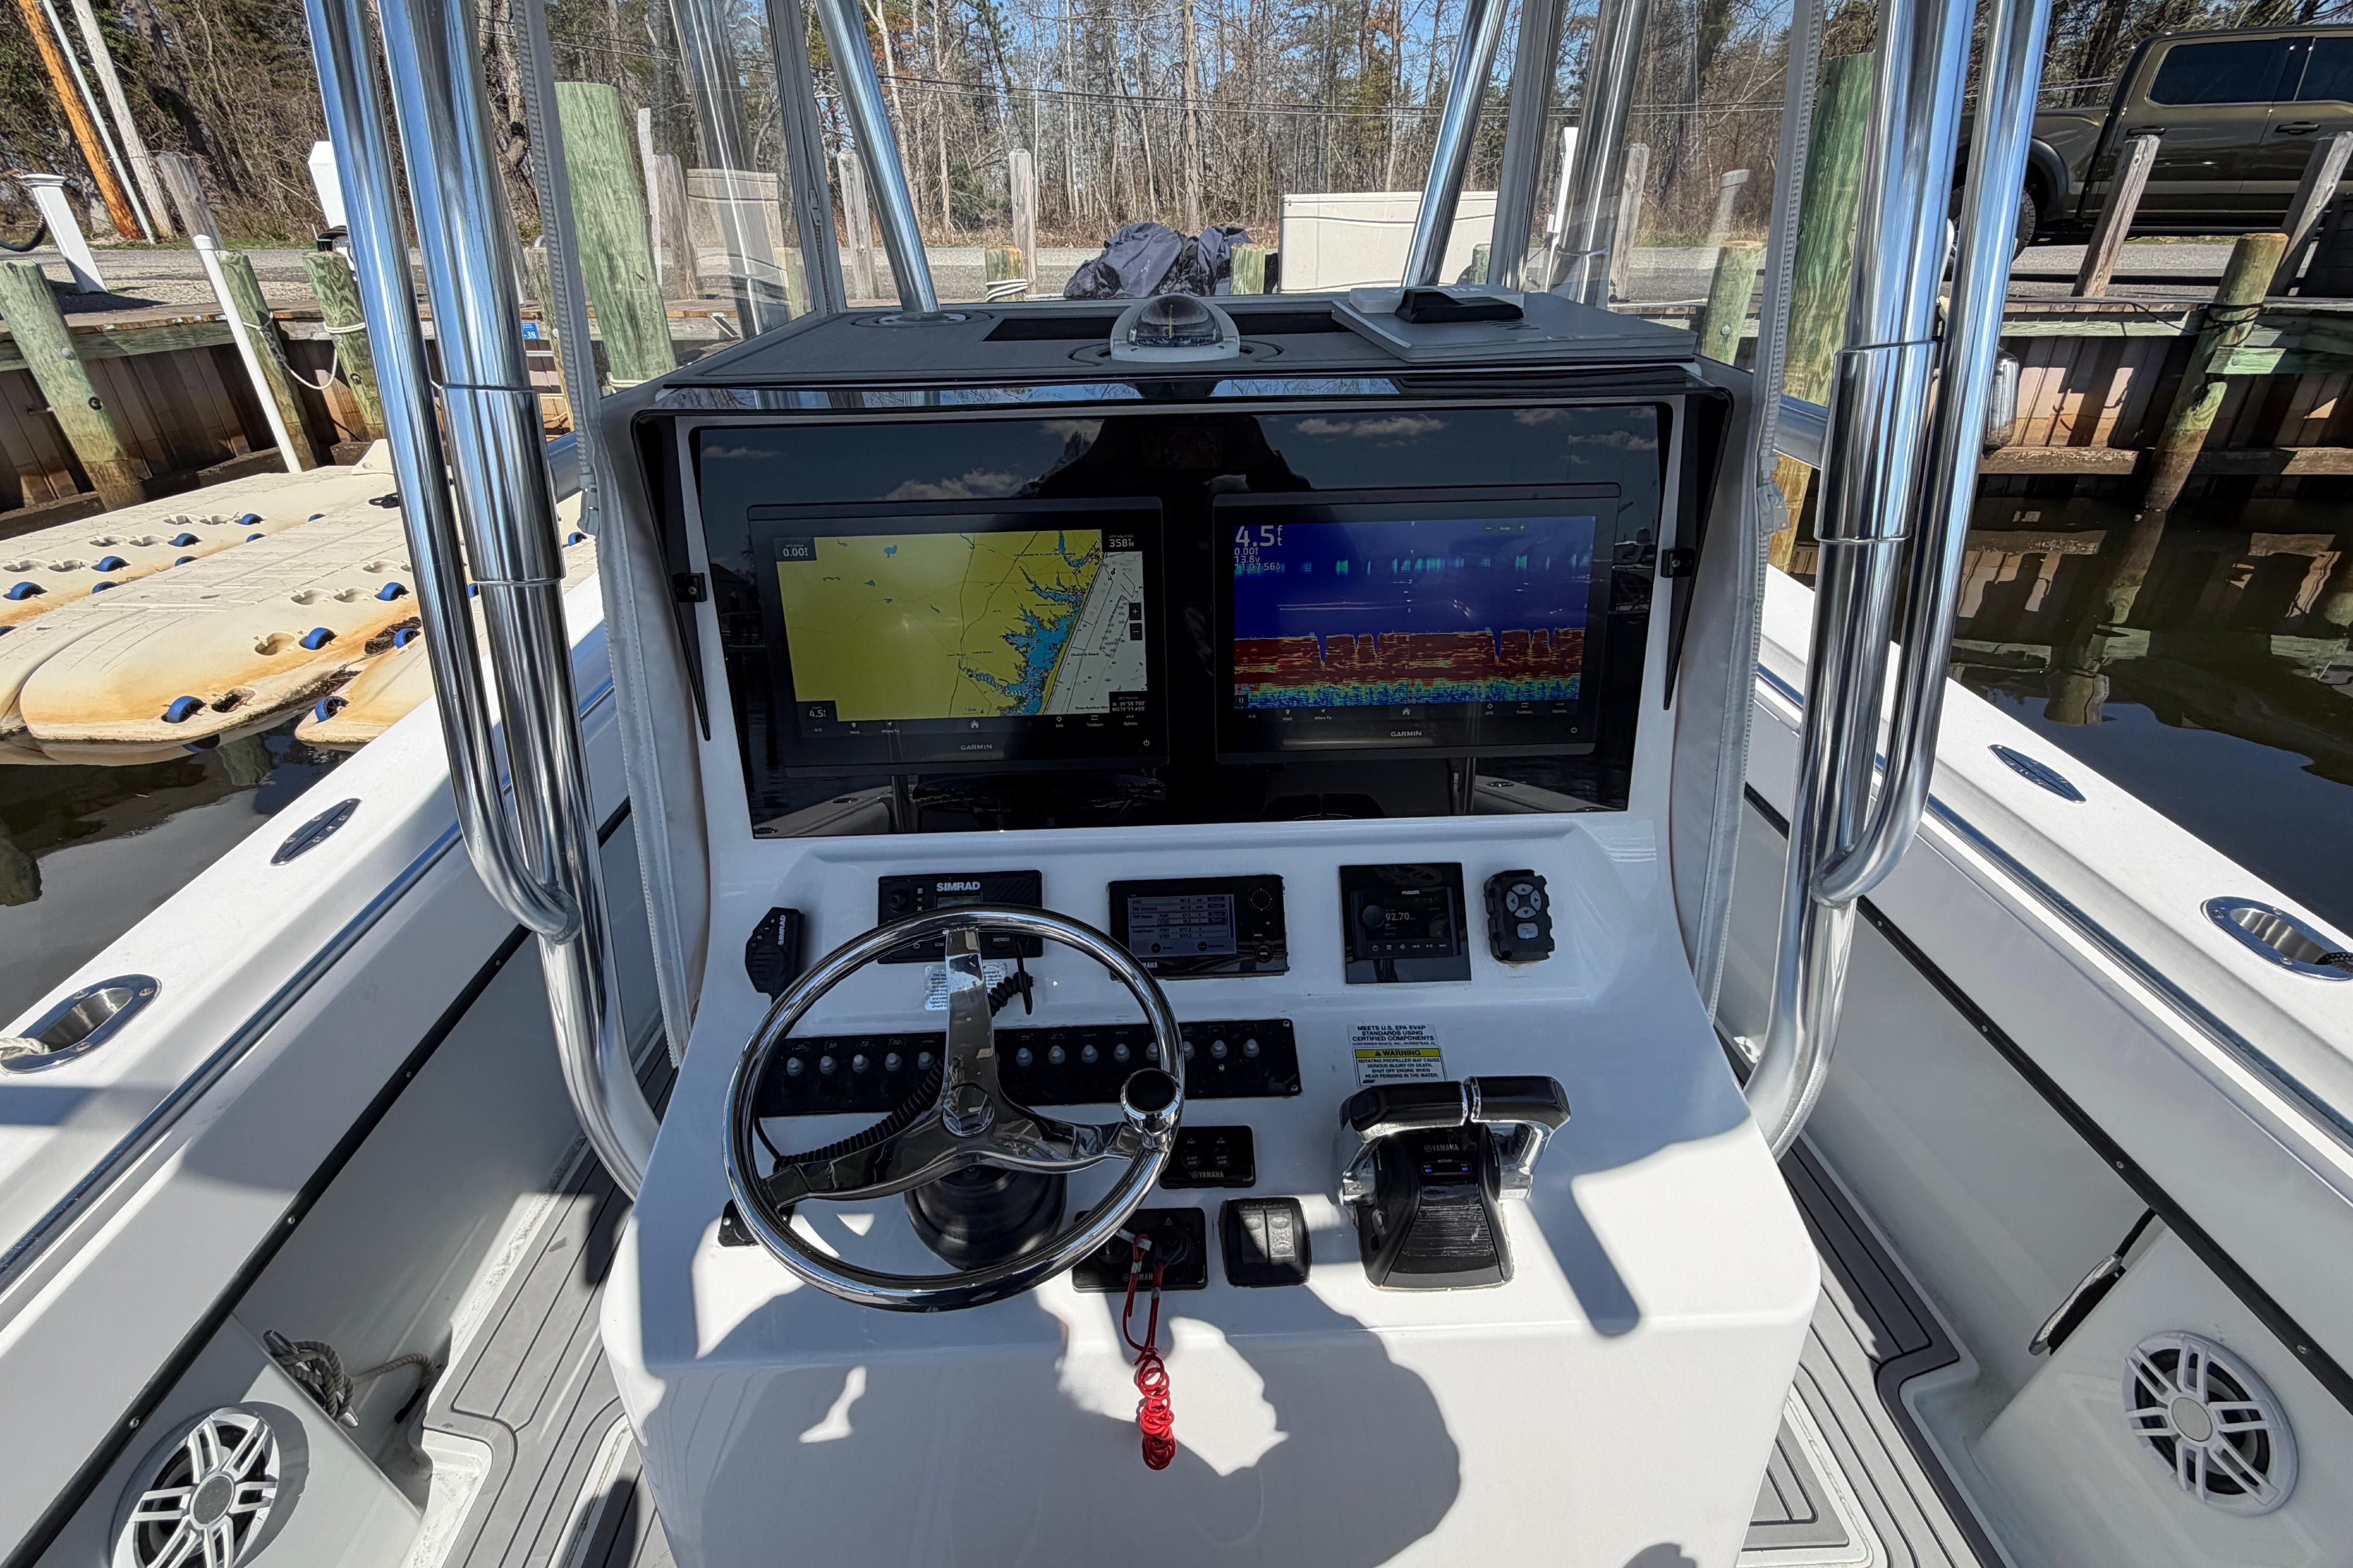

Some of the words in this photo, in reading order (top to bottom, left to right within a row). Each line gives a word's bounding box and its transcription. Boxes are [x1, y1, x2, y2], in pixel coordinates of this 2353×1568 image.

[936, 882, 981, 892] SIMRAD
[1385, 912, 1410, 921] 92.70
[778, 914, 786, 945] SIMRAD
